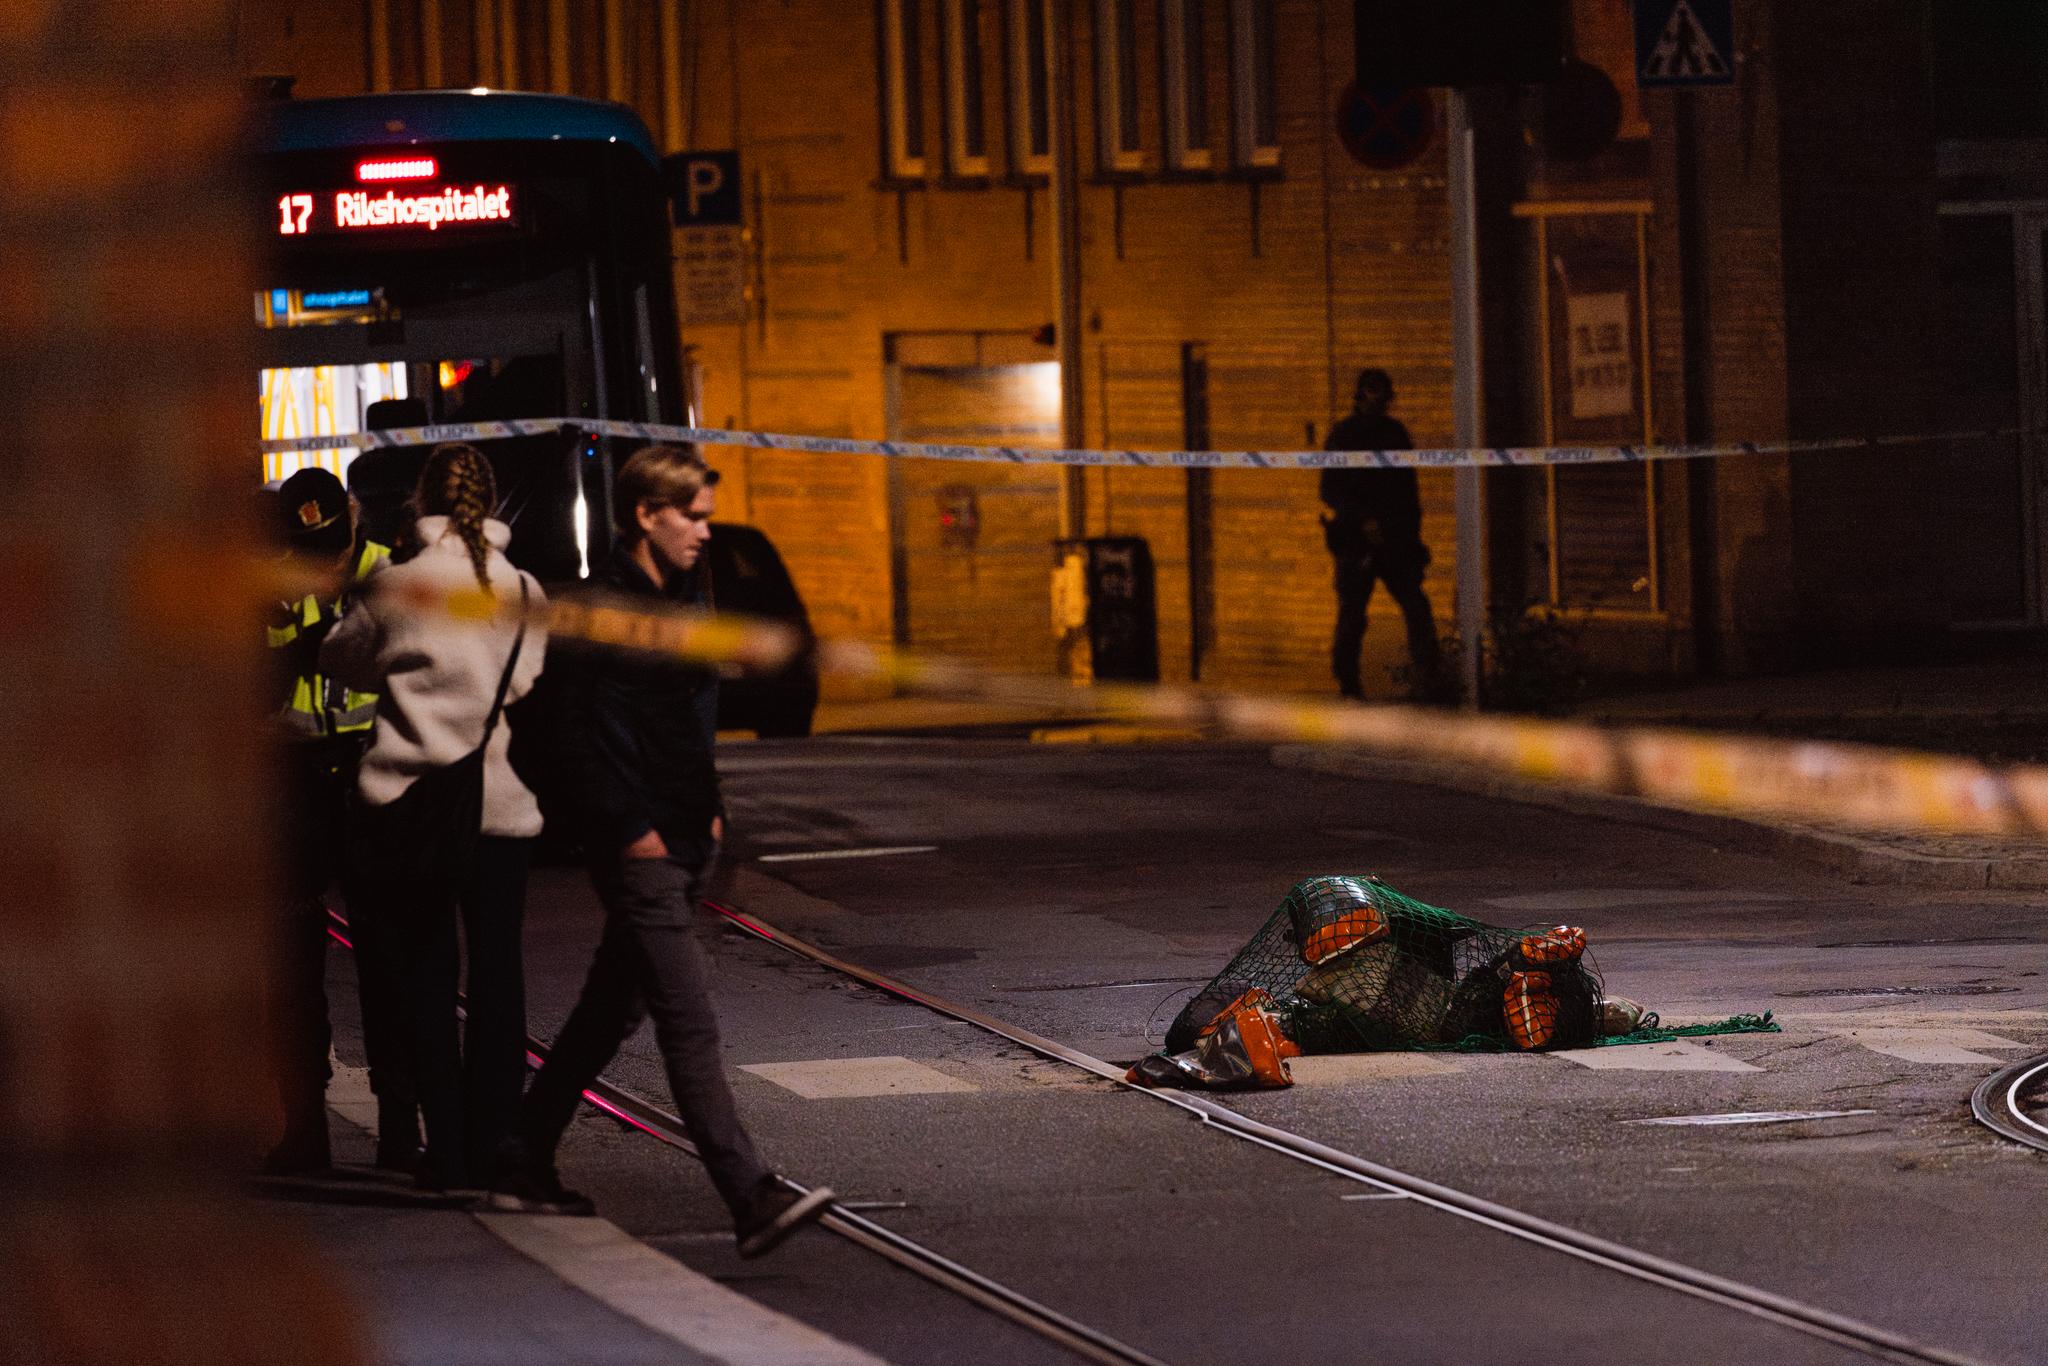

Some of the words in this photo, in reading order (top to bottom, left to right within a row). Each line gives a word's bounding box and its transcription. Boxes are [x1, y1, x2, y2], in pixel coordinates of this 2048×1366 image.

[278, 194, 313, 234] 17
[335, 185, 511, 231] Rikshospitalet
[688, 160, 724, 217] P
